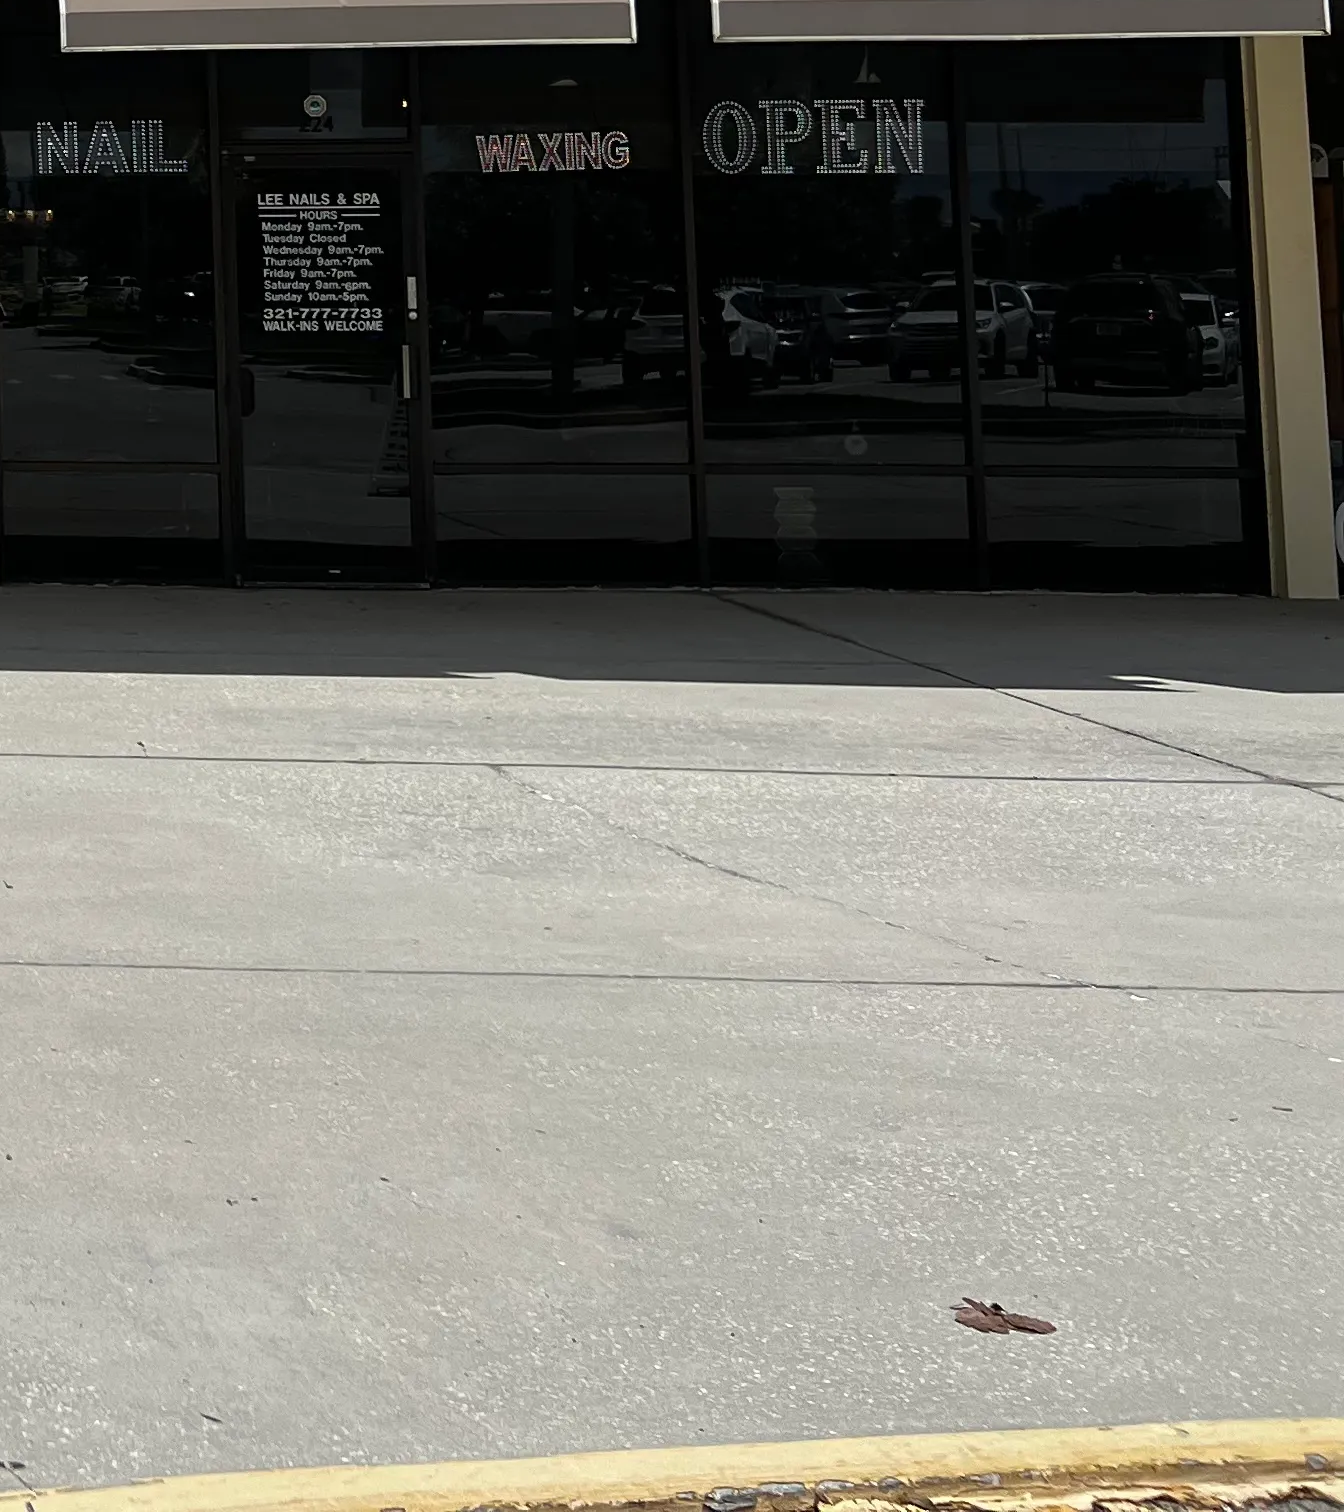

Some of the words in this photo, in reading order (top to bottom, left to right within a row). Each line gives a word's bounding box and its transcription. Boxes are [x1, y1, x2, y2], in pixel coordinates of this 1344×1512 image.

[703, 99, 926, 175] OPEN
[37, 120, 188, 174] NAIL
[475, 131, 630, 173] WAXING
[257, 193, 284, 206] LEE
[289, 193, 331, 205] NAILS
[336, 192, 347, 205] &
[353, 192, 381, 205] SPA
[299, 210, 338, 220] HOURS
[261, 221, 302, 232] Monday
[262, 234, 304, 244] Tuesday
[309, 233, 347, 243] Closed
[262, 245, 323, 256] Wednesday
[263, 256, 312, 267] Thursday
[263, 268, 295, 279] Friday
[264, 280, 310, 291] Saturday
[264, 292, 303, 303] Sunday
[263, 308, 384, 319] 321-777-7733
[263, 320, 320, 332] WALK-INS
[324, 320, 384, 332] WELCOME
